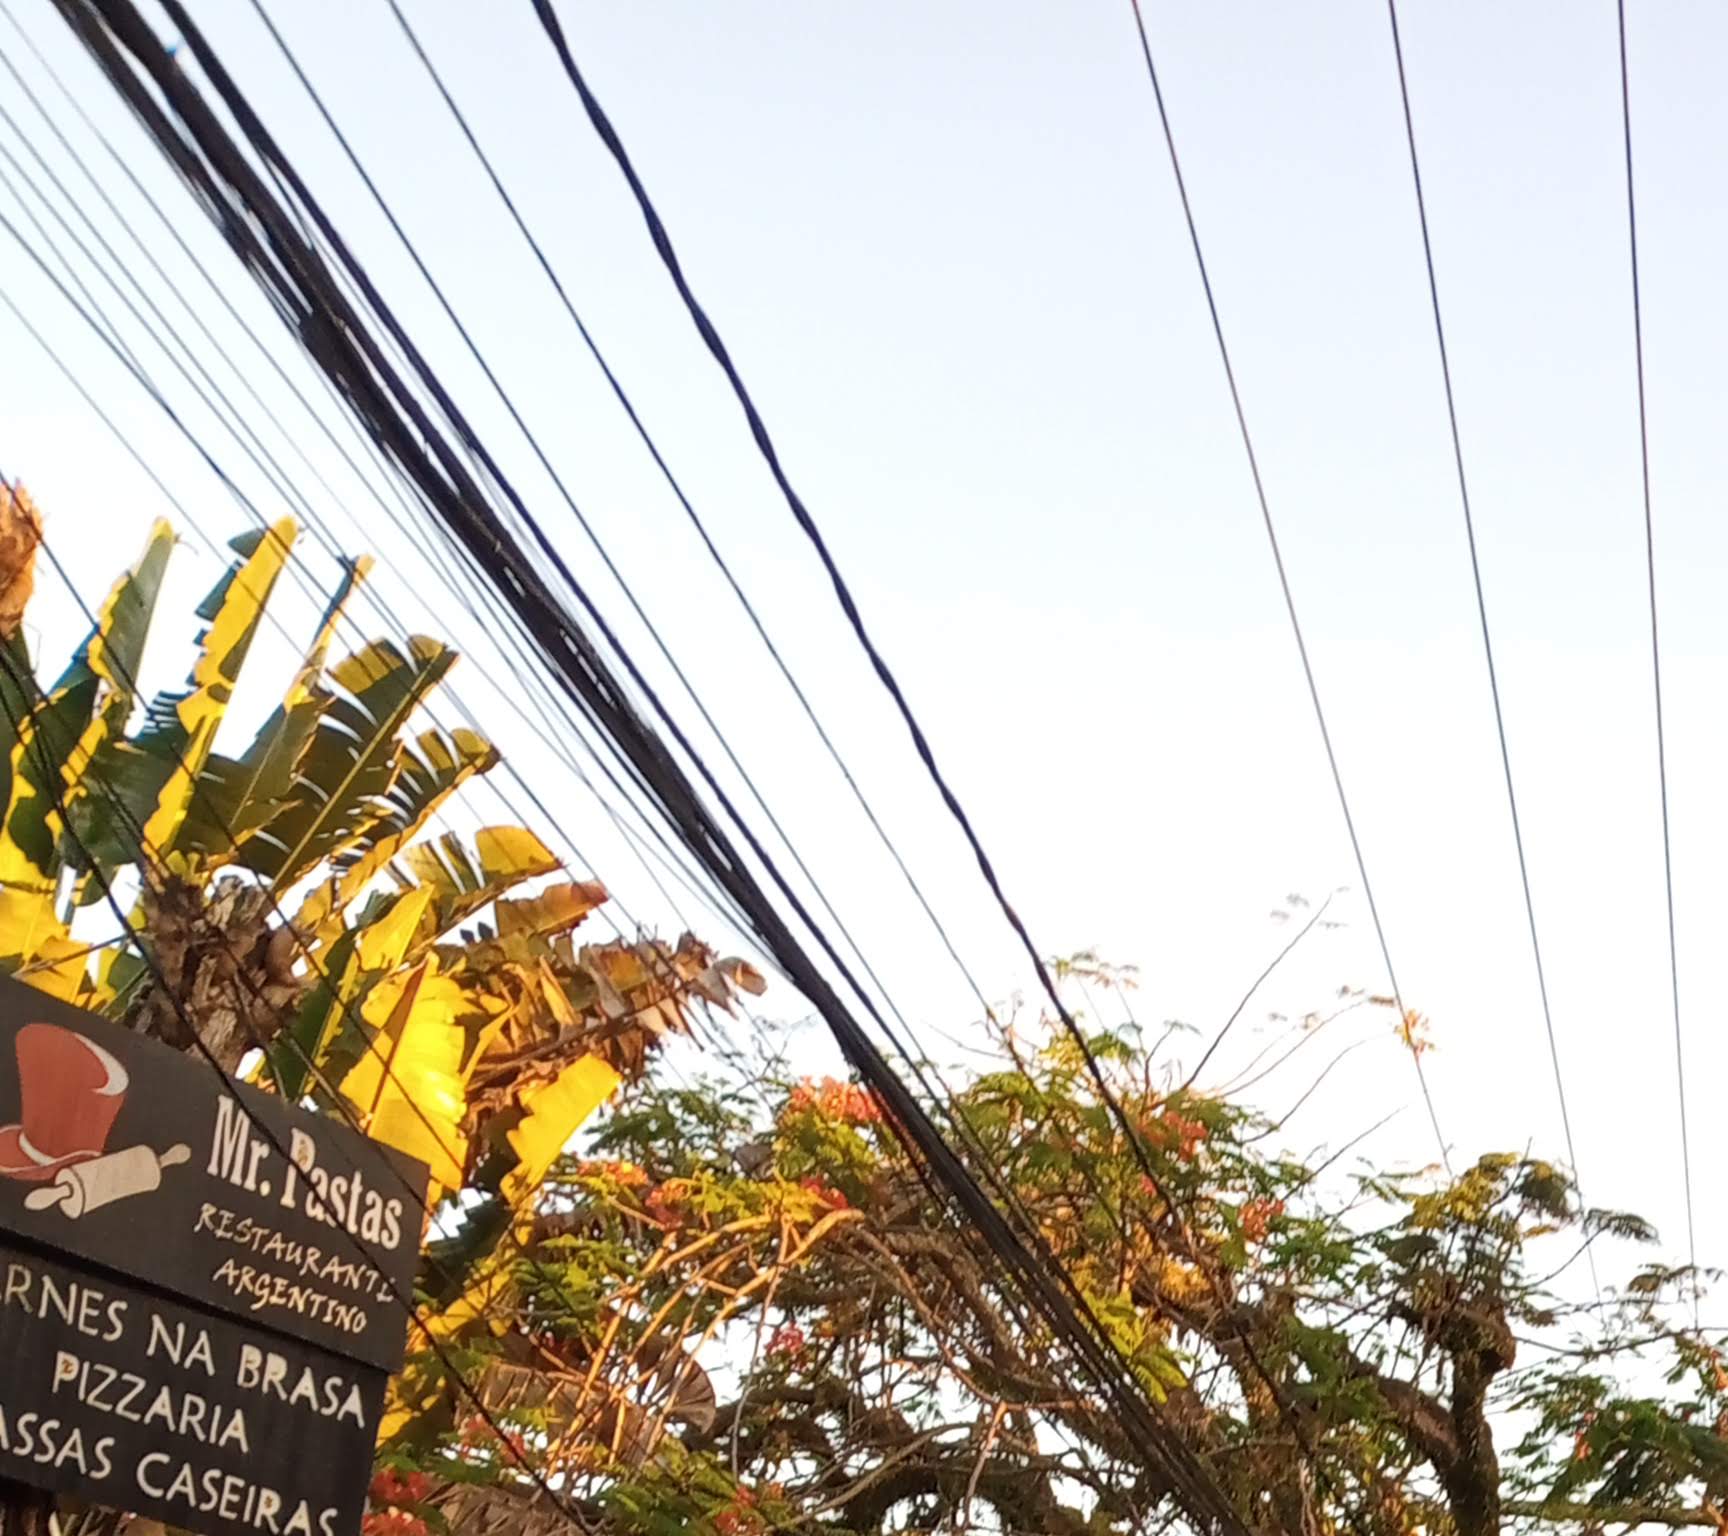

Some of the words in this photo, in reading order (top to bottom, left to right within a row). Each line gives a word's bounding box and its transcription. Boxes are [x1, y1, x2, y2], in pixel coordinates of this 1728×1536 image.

[206, 1094, 271, 1198] Mr.
[280, 1126, 403, 1251] Pastas
[193, 1202, 397, 1304] RESTAURANTE
[212, 1258, 367, 1334] ARGENTINO
[0, 1263, 128, 1341] RNES
[147, 1314, 215, 1376] NA
[237, 1343, 366, 1430] BRASA
[53, 1350, 249, 1454] PIZZARIA
